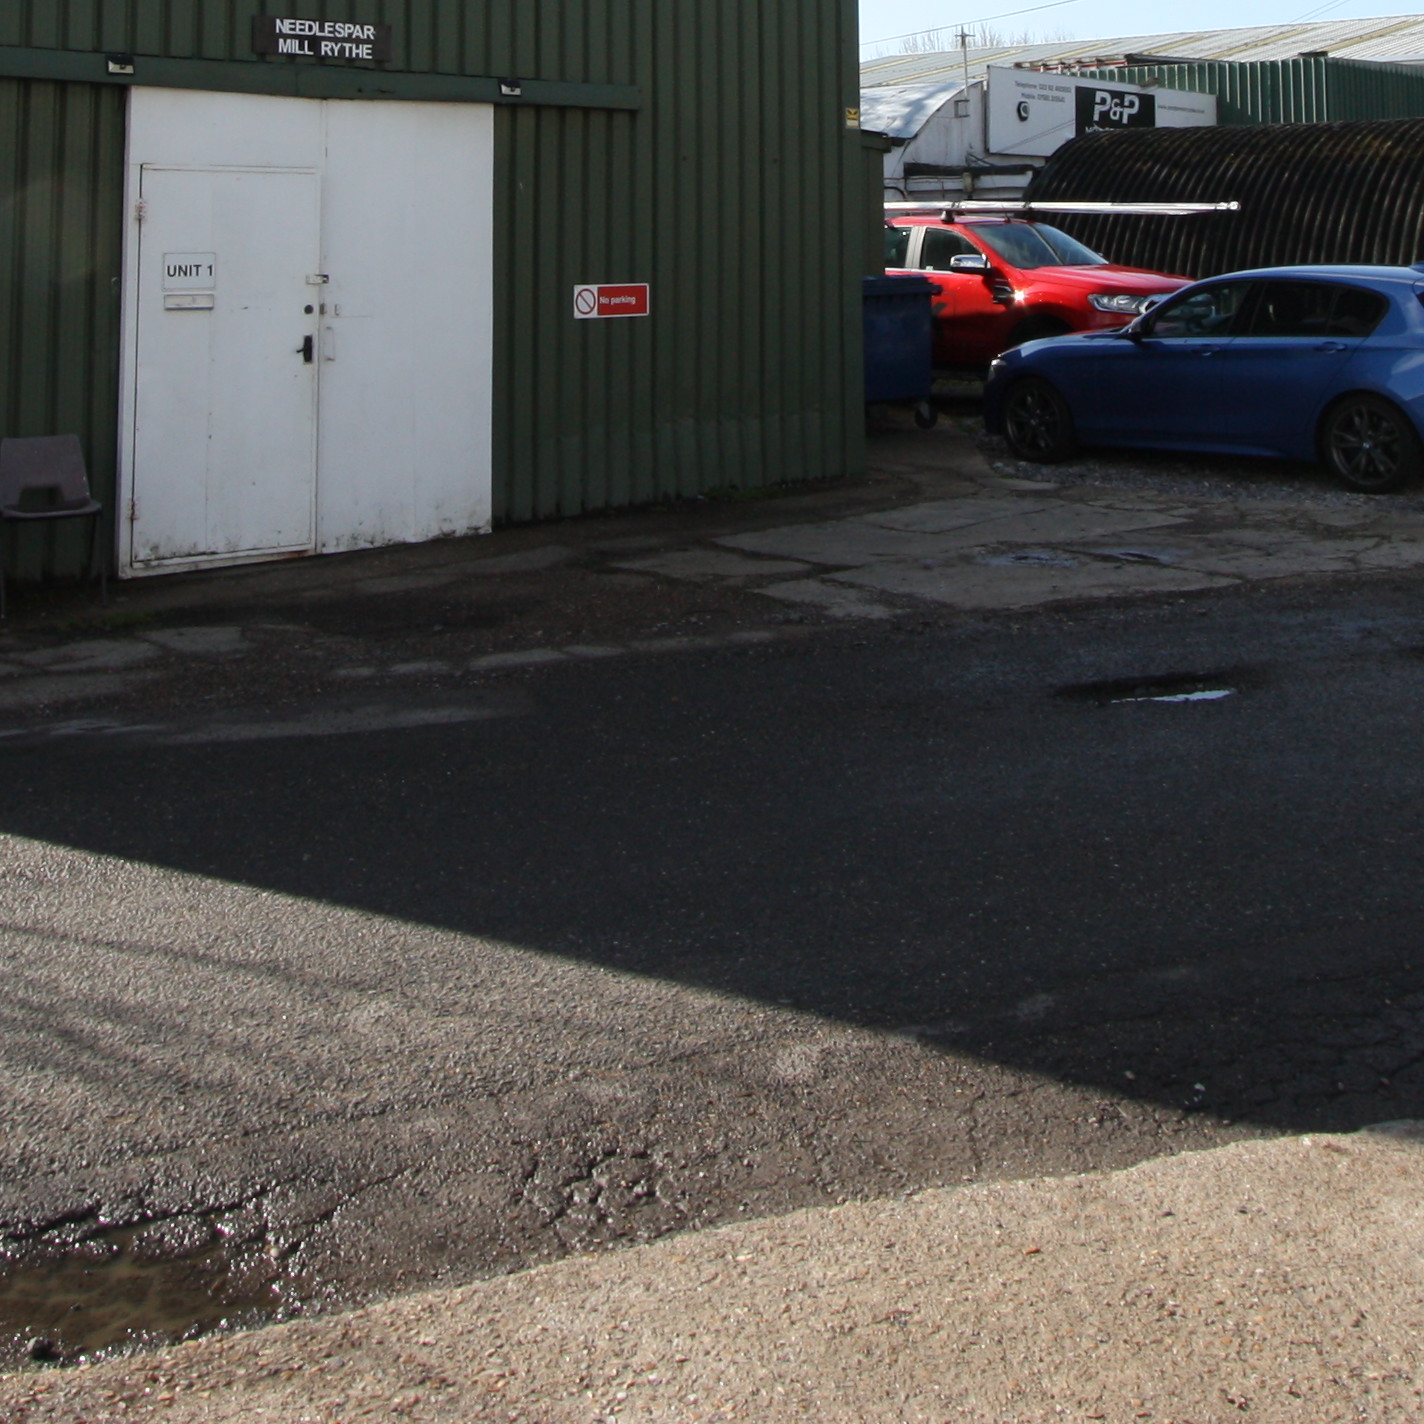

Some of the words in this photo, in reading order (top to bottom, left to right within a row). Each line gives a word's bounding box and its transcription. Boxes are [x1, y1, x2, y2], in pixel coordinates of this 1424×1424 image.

[275, 18, 374, 40] NEEDLESPAR
[278, 38, 314, 55] MILL
[320, 40, 373, 59] RYTHE
[1093, 90, 1140, 124] P&P
[167, 264, 202, 277] UNIT
[207, 264, 213, 277] 1
[599, 296, 609, 304] No
[610, 295, 636, 306] parking
